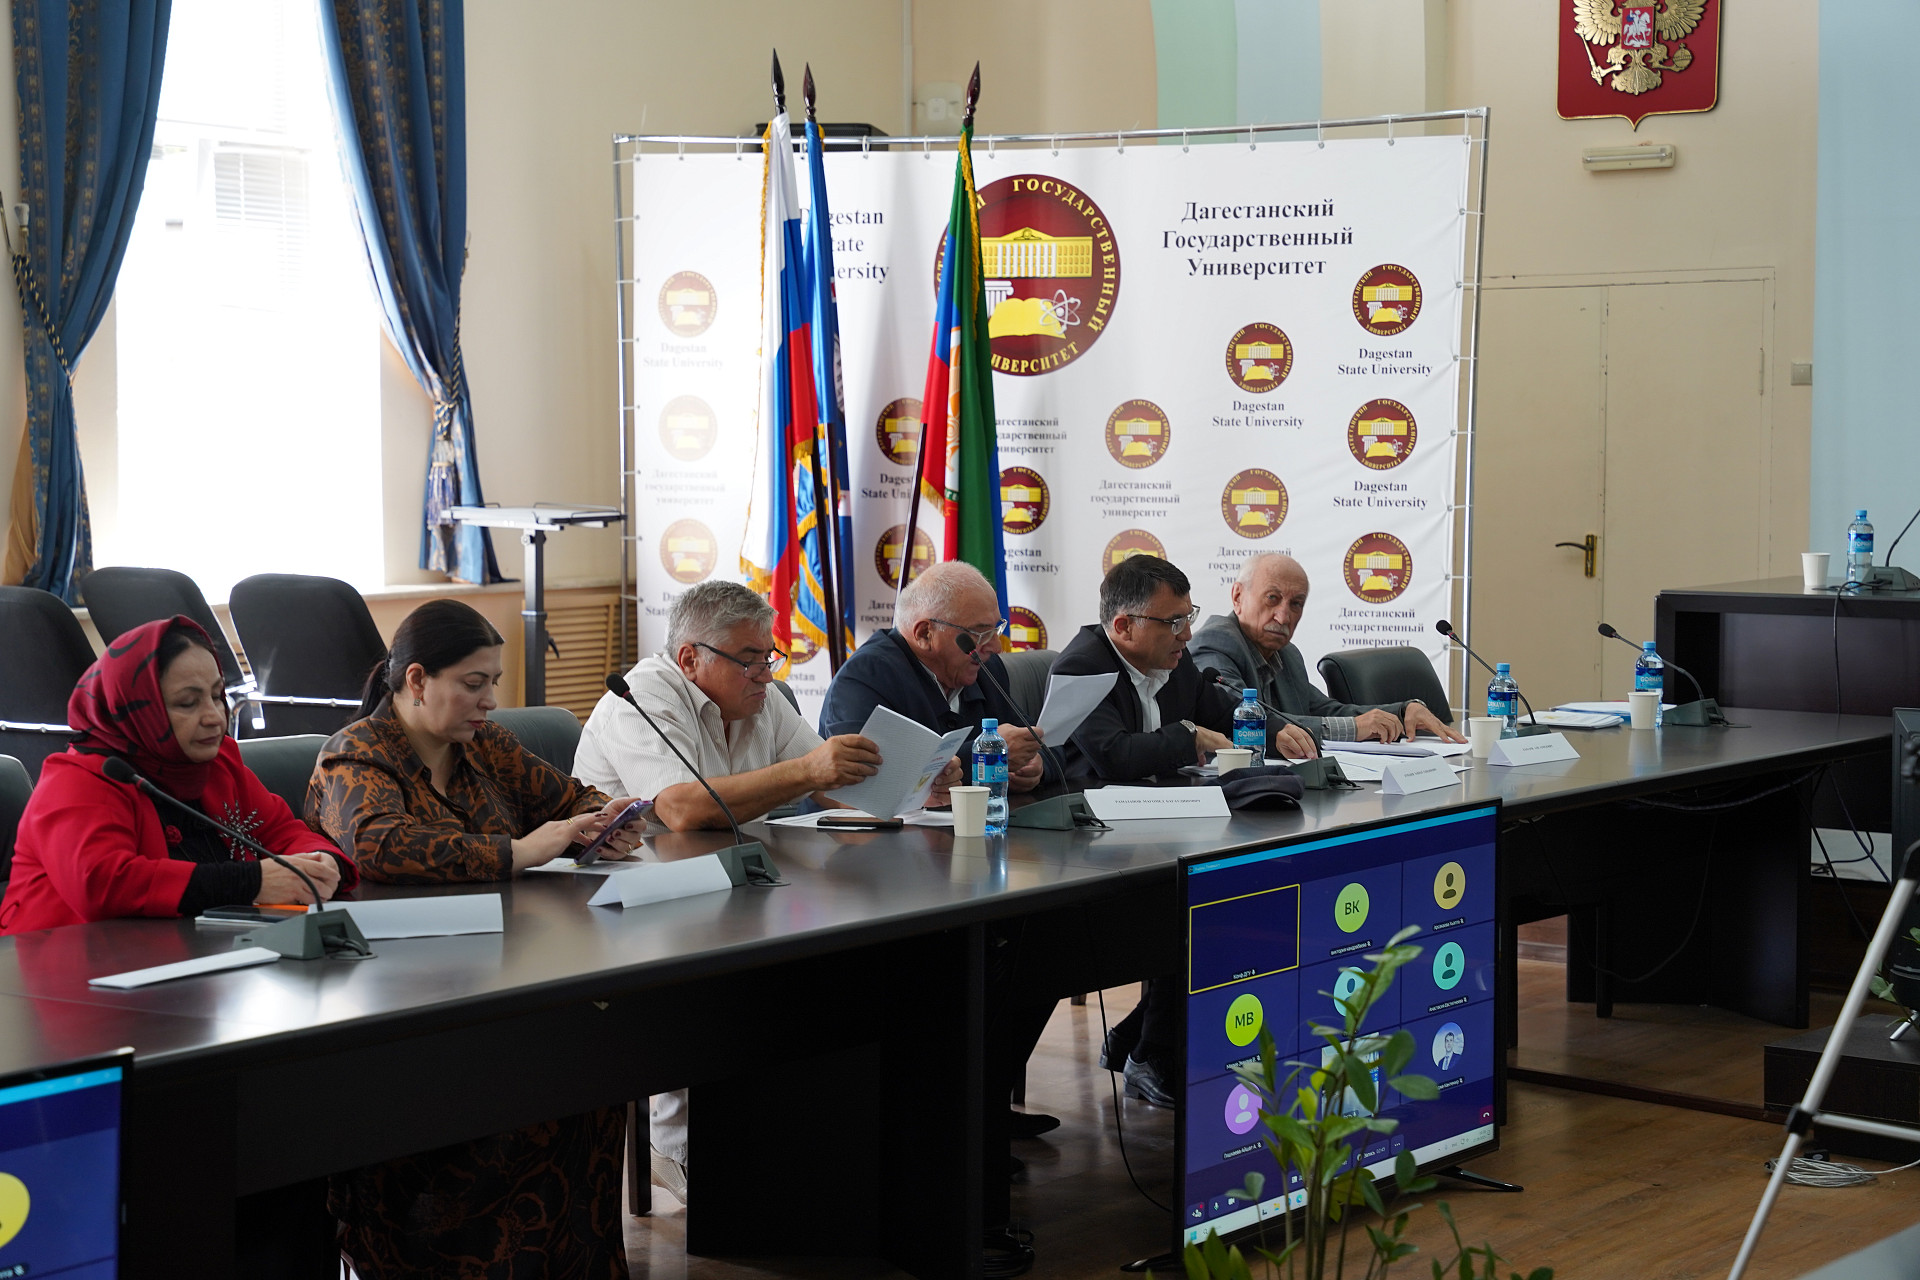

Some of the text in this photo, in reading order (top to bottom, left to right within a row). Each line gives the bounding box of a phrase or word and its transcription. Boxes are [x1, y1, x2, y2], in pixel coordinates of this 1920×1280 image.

[799, 208, 884, 227] Dgestan
[1181, 199, 1335, 223] Дагестанский
[1162, 227, 1354, 253] Государственный
[1012, 178, 1116, 333] ГОСУДАРСТВЕННЫЙ
[837, 262, 889, 284] ersity
[1187, 257, 1327, 280] Университет
[990, 341, 1079, 373] ИВЕРСИТЕТ
[1358, 348, 1413, 362] Dagestan
[1337, 363, 1433, 377] State University
[1232, 401, 1285, 414] Dagestan
[996, 418, 1059, 427] агестанский
[1212, 416, 1304, 429] State University
[1099, 480, 1172, 490] Дагестанский
[1354, 481, 1408, 494] Dagestan
[862, 488, 888, 498] State
[1090, 494, 1180, 505] государственный
[1333, 496, 1428, 510] State University
[1102, 508, 1168, 519] университет
[1338, 607, 1415, 619] Дагестанский
[1329, 622, 1424, 634] государственный
[1342, 637, 1411, 648] университет
